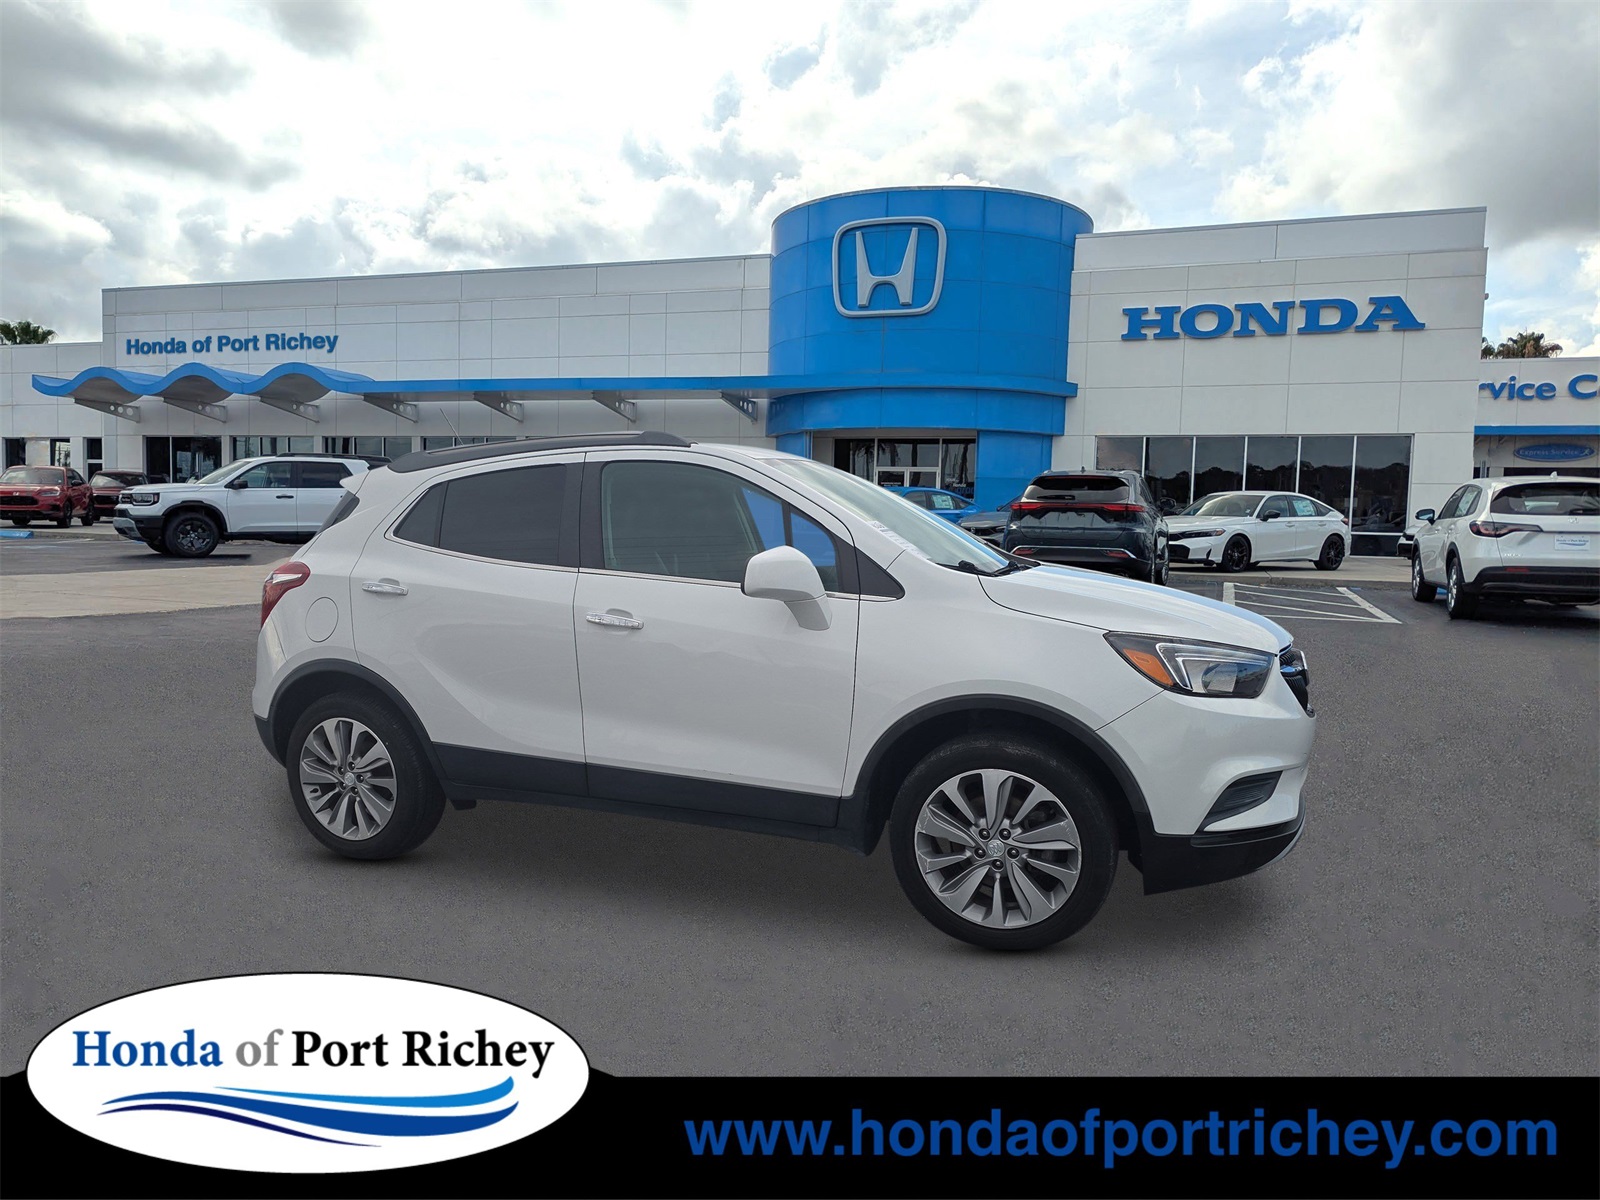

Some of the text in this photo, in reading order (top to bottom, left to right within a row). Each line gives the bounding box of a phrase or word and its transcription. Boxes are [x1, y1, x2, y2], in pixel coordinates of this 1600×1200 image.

[1121, 295, 1426, 341] HONDA
[126, 332, 339, 355] Honda of Port Richey
[1568, 374, 1600, 400] C
